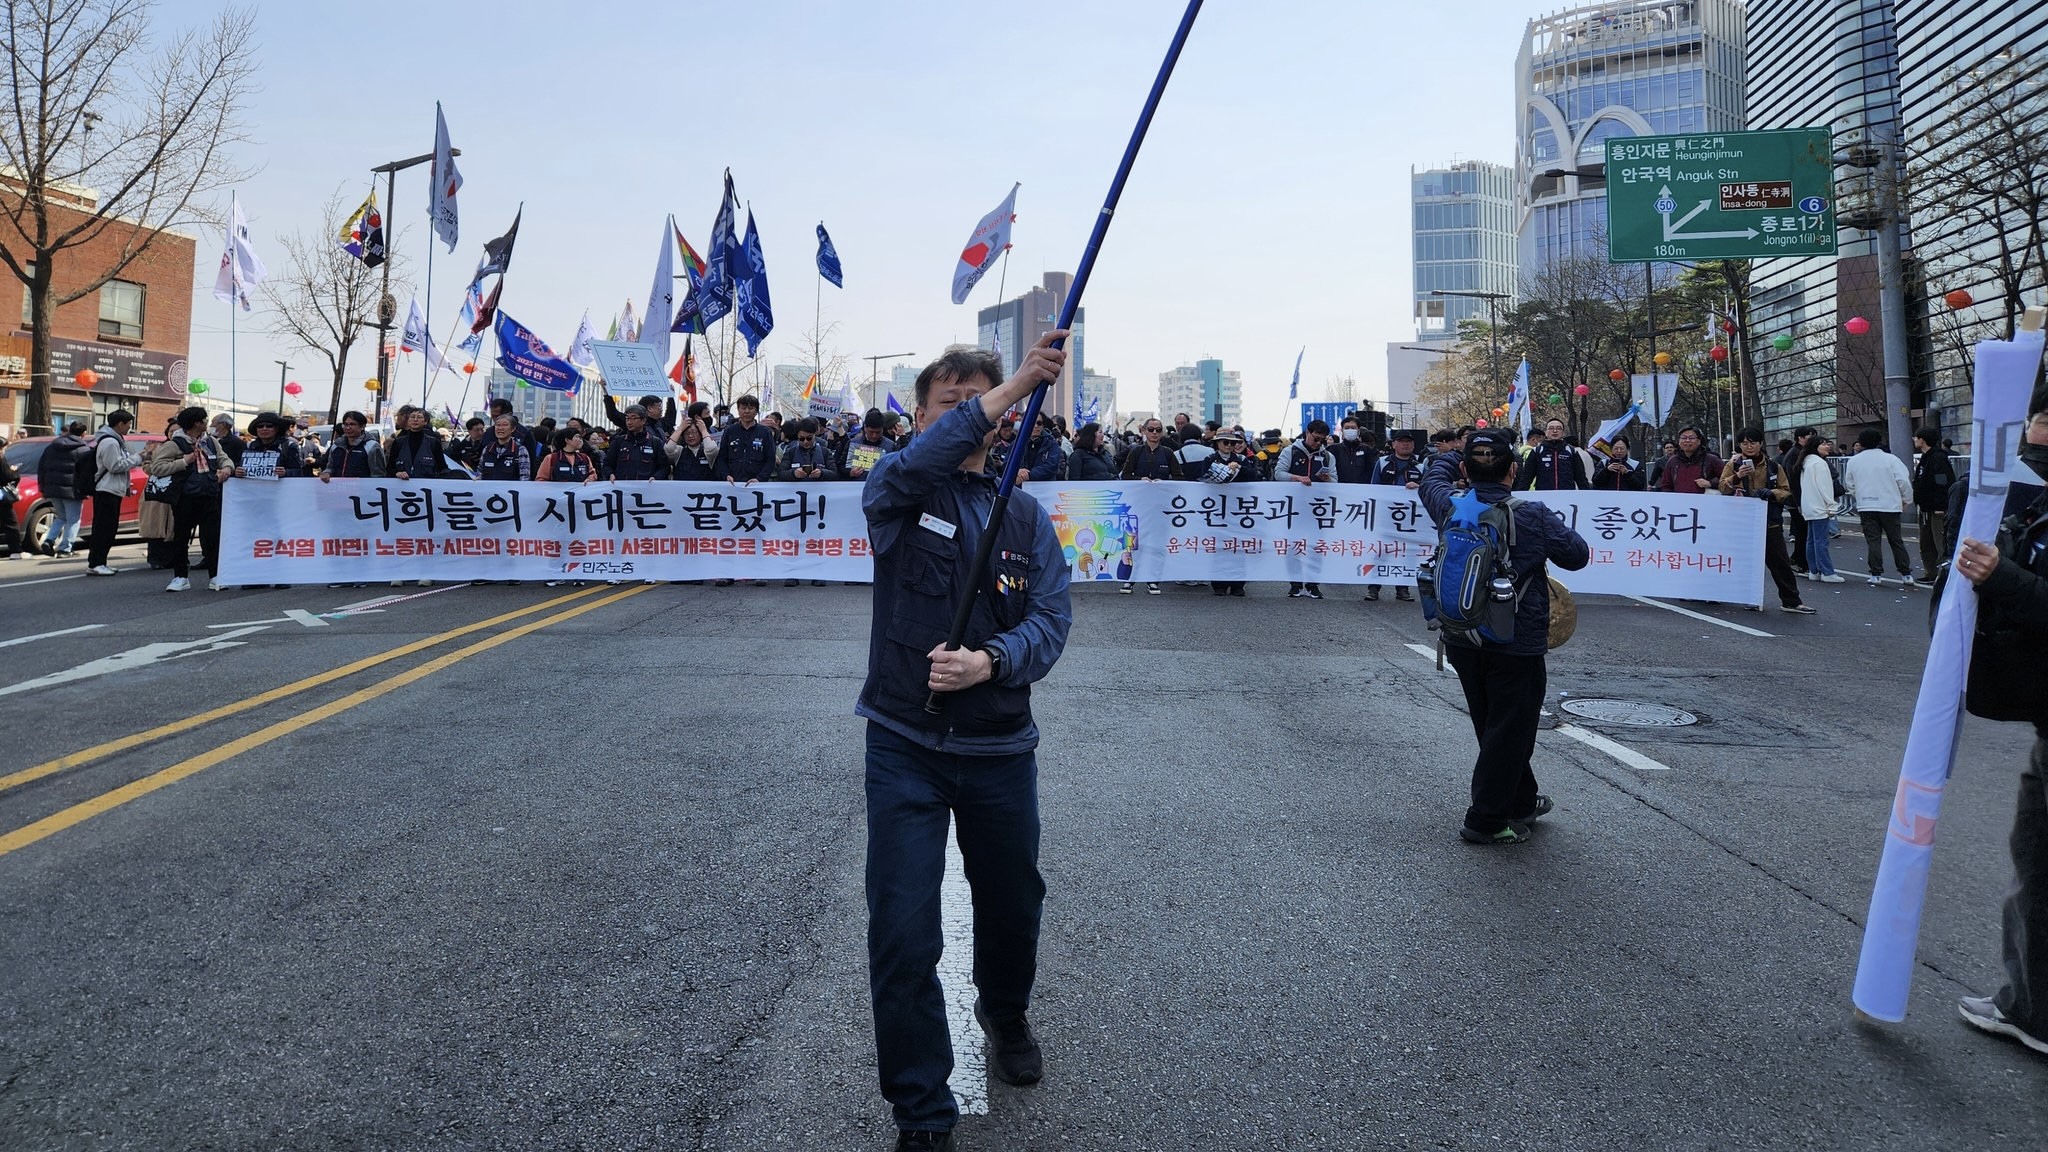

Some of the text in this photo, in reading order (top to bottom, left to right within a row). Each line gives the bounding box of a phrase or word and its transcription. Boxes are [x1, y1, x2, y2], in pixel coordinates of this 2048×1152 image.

[1675, 137, 1725, 150] 興仁之門
[1611, 143, 1671, 161] 흥인지문
[1675, 149, 1743, 161] Heunginjimun
[1621, 165, 1672, 184] 안국역
[1676, 169, 1738, 183] Anguk Stn
[1721, 184, 1759, 198] 인사동
[1659, 201, 1672, 211] 50
[1722, 200, 1767, 209] Insa-dong
[1809, 200, 1818, 211] 6
[1760, 214, 1825, 232] 종로1가
[1763, 234, 1798, 247] Jongno
[1653, 245, 1686, 256] 180m
[610, 365, 635, 375] 피청구인
[349, 487, 826, 533] 너희들의 시대는 끝났다!
[1163, 494, 1421, 532] 응원봉과 함께 한
[1592, 505, 1706, 544] 좋았다
[253, 538, 315, 558] 윤석열
[322, 538, 368, 557] 파면!
[506, 538, 561, 558] 위대한
[568, 538, 614, 557] 승리!
[621, 537, 756, 556] 사회대개혁으로
[762, 538, 799, 557] 빛의
[805, 538, 842, 556] 혁명
[1166, 536, 1216, 554] 윤석열
[1223, 538, 1262, 555] 파면!
[1273, 539, 1307, 556] 맘껏
[1313, 538, 1406, 558] 축하합시다!
[582, 561, 634, 574] 민주노총
[1626, 549, 1732, 574] 감사합니다!
